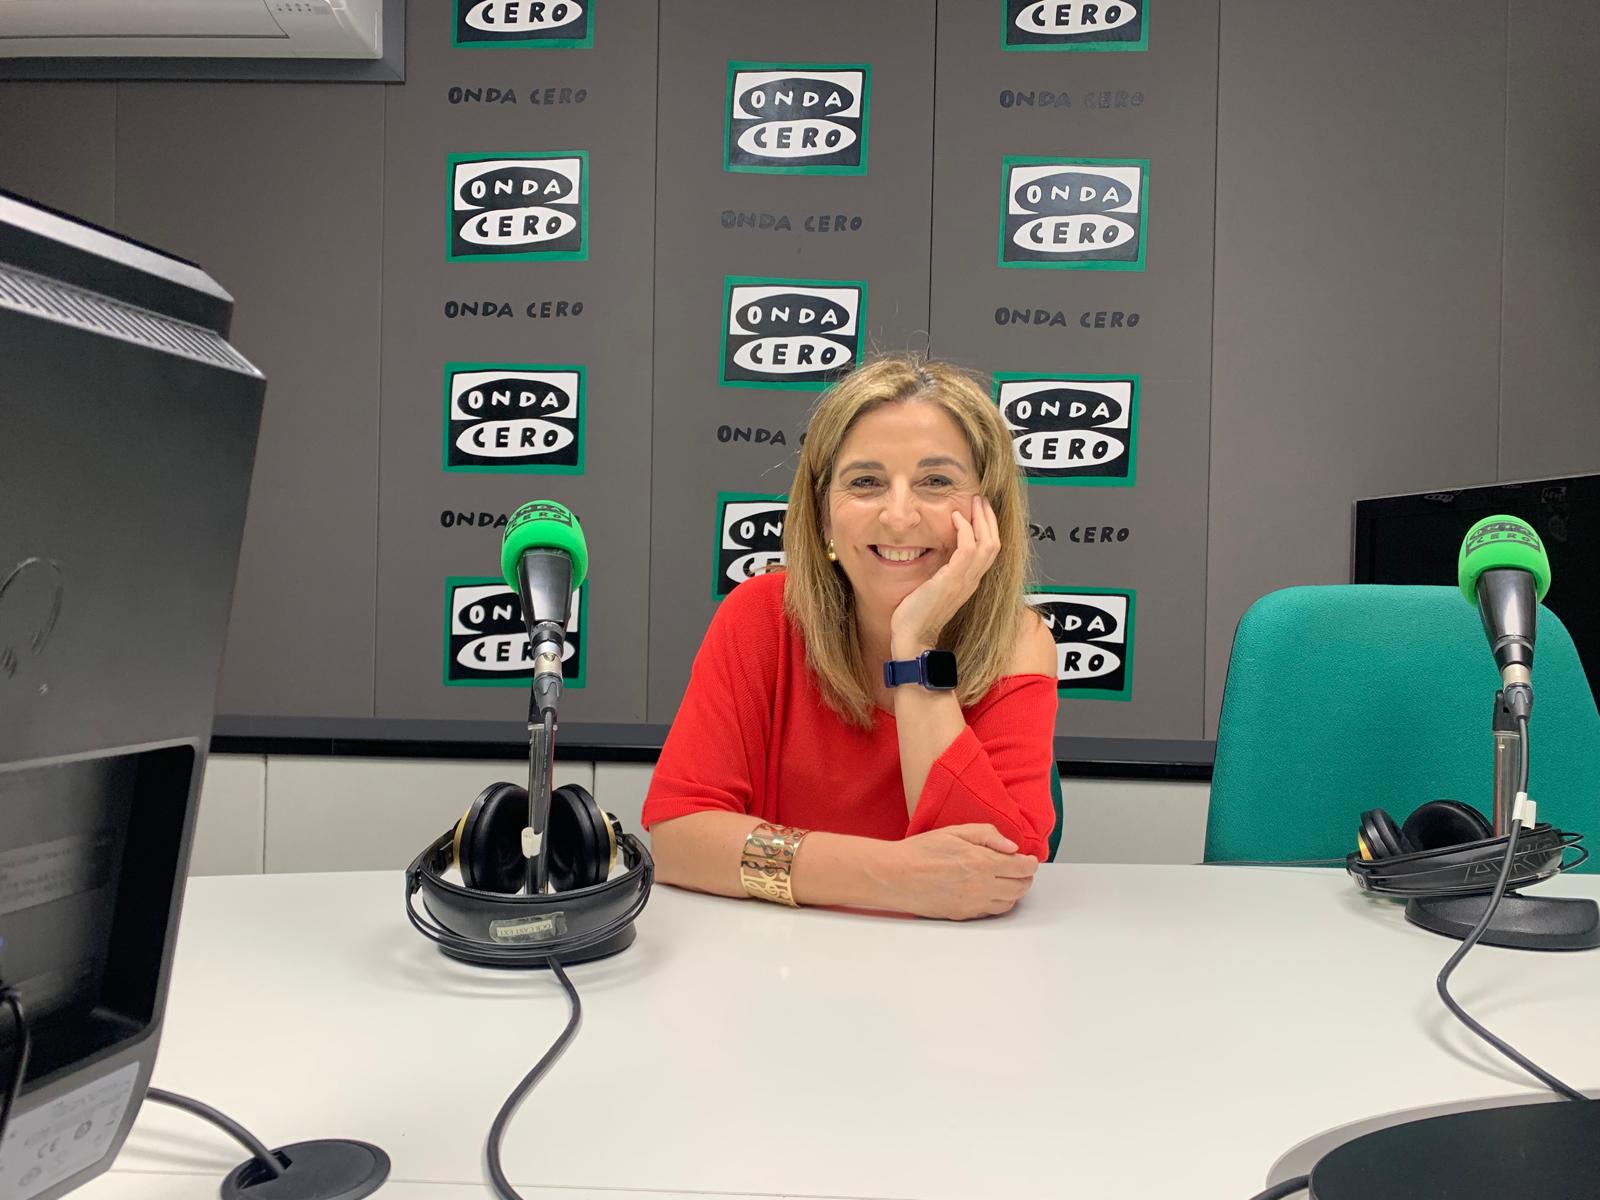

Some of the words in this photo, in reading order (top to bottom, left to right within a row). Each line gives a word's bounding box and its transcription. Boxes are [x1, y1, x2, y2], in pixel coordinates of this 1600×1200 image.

[481, 1, 568, 24] CERO
[1031, 4, 1122, 26] CERO
[447, 86, 517, 105] ONDA
[530, 87, 587, 105] CERO
[750, 90, 842, 109] ONDA
[1000, 89, 1072, 108] ONDA
[1084, 89, 1144, 109] CERO
[752, 127, 842, 149] CERO
[471, 178, 561, 199] ONDA
[1026, 185, 1120, 204] ONDA
[475, 215, 562, 238] CERO
[720, 210, 792, 231] ONDA
[804, 214, 862, 232] CERO
[1029, 222, 1120, 244] CERO
[444, 300, 514, 318] ONDA
[526, 301, 584, 318] CERO
[747, 305, 838, 325] ONDA
[994, 307, 1067, 327] ONDA
[1079, 311, 1141, 329] CERO
[749, 343, 837, 365] CERO
[468, 390, 559, 410] ONDA
[1016, 400, 1110, 419] ONDA
[472, 426, 559, 448] CERO
[717, 424, 787, 446] ONDA
[1019, 437, 1109, 460] CERO
[440, 510, 507, 528] ONDA
[739, 520, 783, 540] ON
[1028, 523, 1057, 543] DA
[1069, 526, 1130, 543] CERO
[469, 604, 525, 625] ON
[473, 640, 535, 662] CER
[1063, 651, 1105, 672] RO
